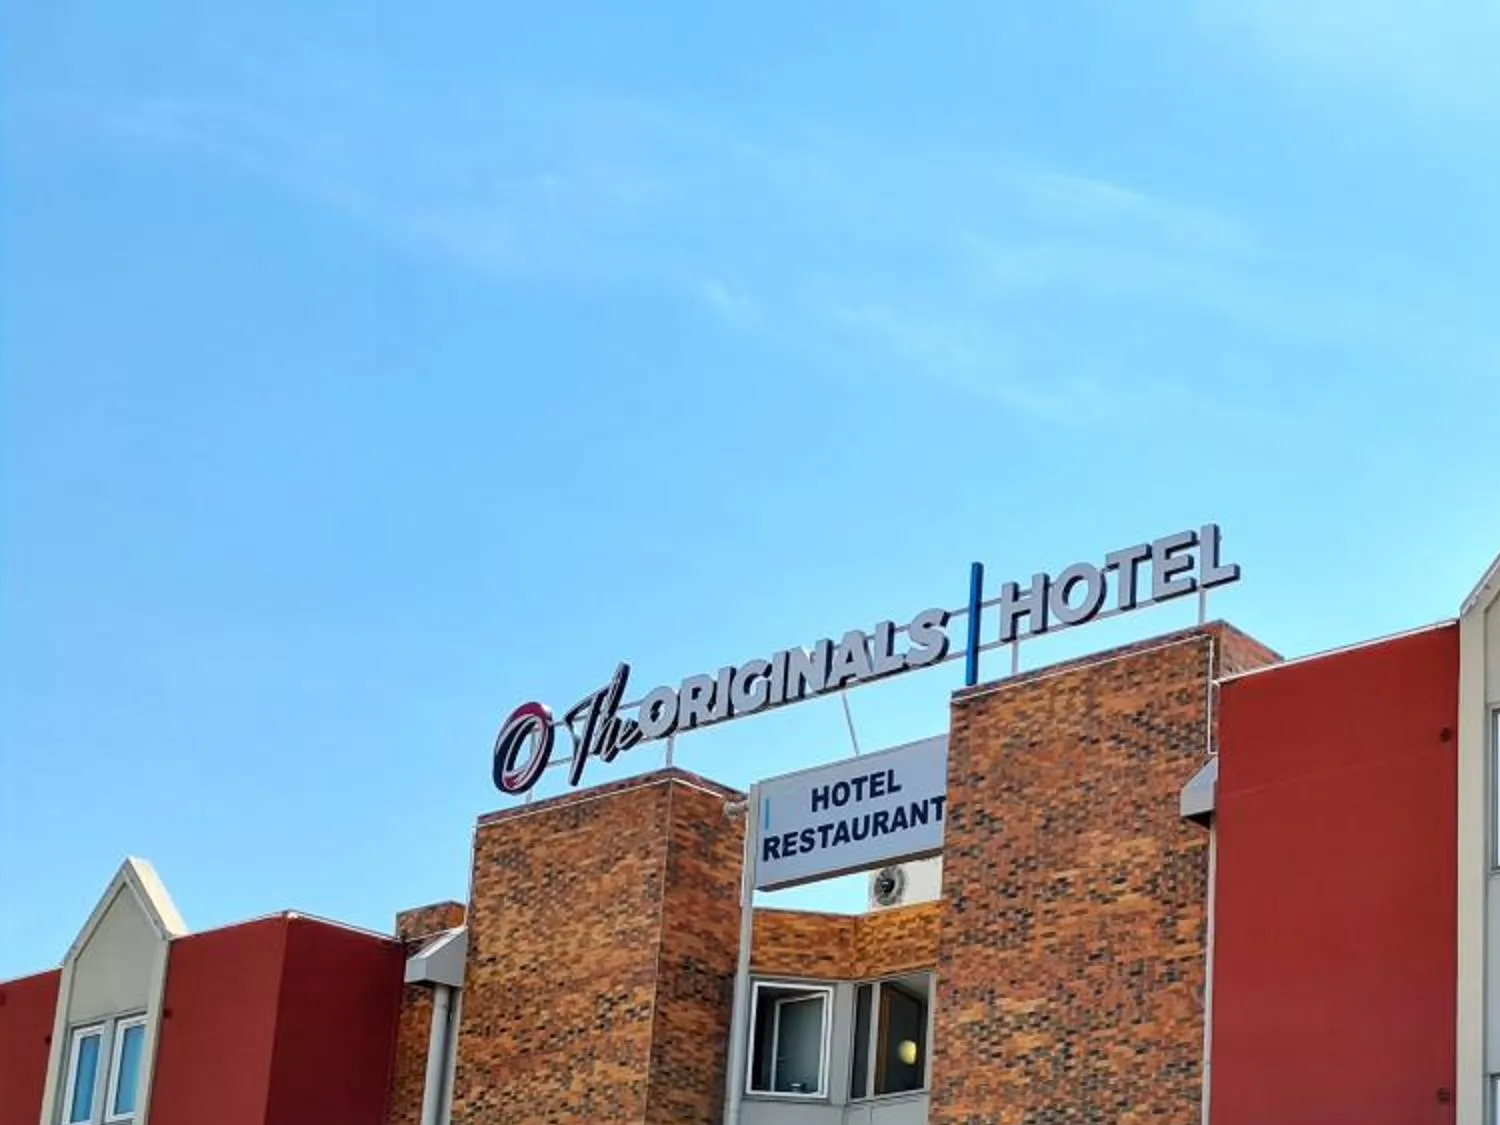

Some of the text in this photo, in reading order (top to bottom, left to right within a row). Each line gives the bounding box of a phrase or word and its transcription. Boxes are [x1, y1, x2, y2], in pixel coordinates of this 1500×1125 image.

[565, 660, 646, 786] The
[640, 608, 949, 738] ORIGINALS
[1000, 523, 1240, 643] HOTEL
[811, 769, 902, 812] HOTEL
[763, 796, 947, 861] RESTAURANT
